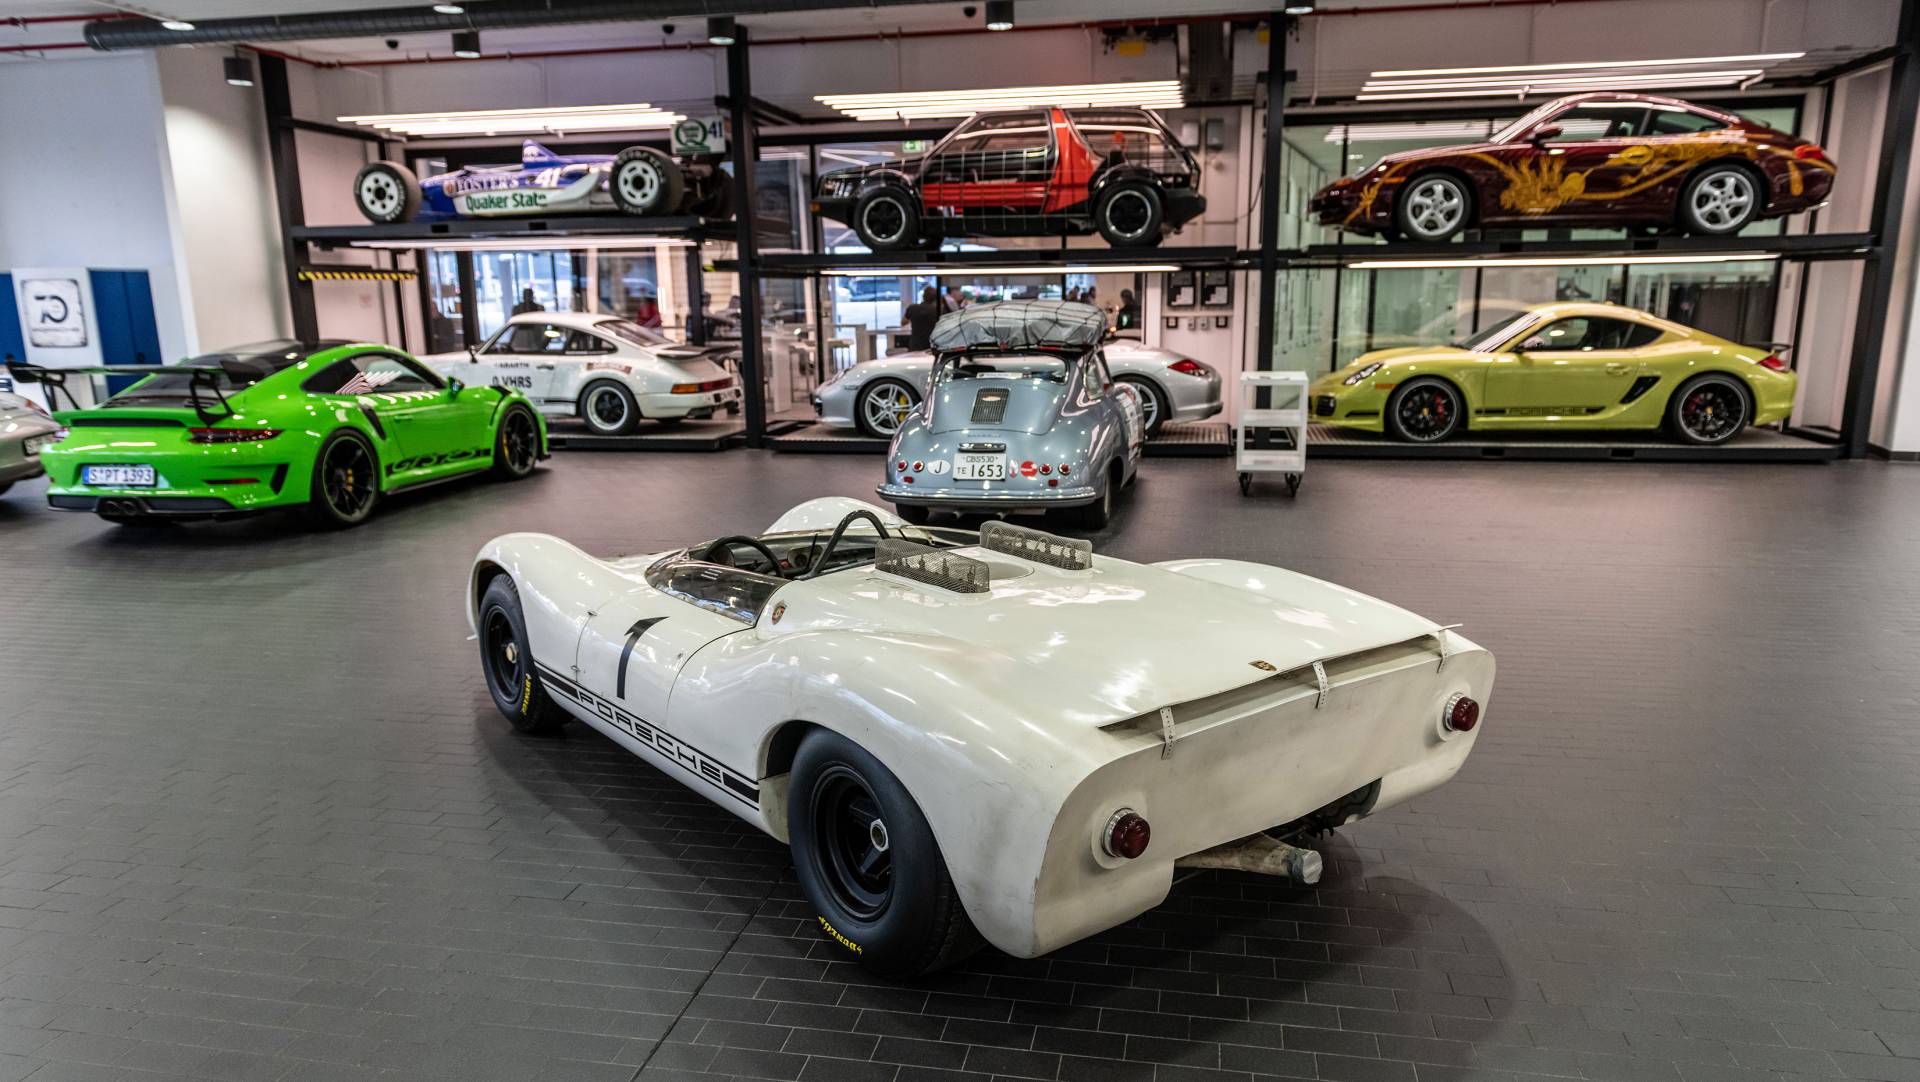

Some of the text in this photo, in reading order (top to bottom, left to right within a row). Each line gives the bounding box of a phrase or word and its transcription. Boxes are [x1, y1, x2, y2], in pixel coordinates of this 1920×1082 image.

[535, 168, 561, 187] 41
[465, 194, 508, 211] Quaker
[502, 376, 532, 388] VHRS
[90, 467, 152, 482] S PT 1393
[934, 461, 943, 474] J
[957, 464, 1003, 478] TE 1653
[616, 616, 670, 700] 1
[578, 690, 722, 783] PORSCHE
